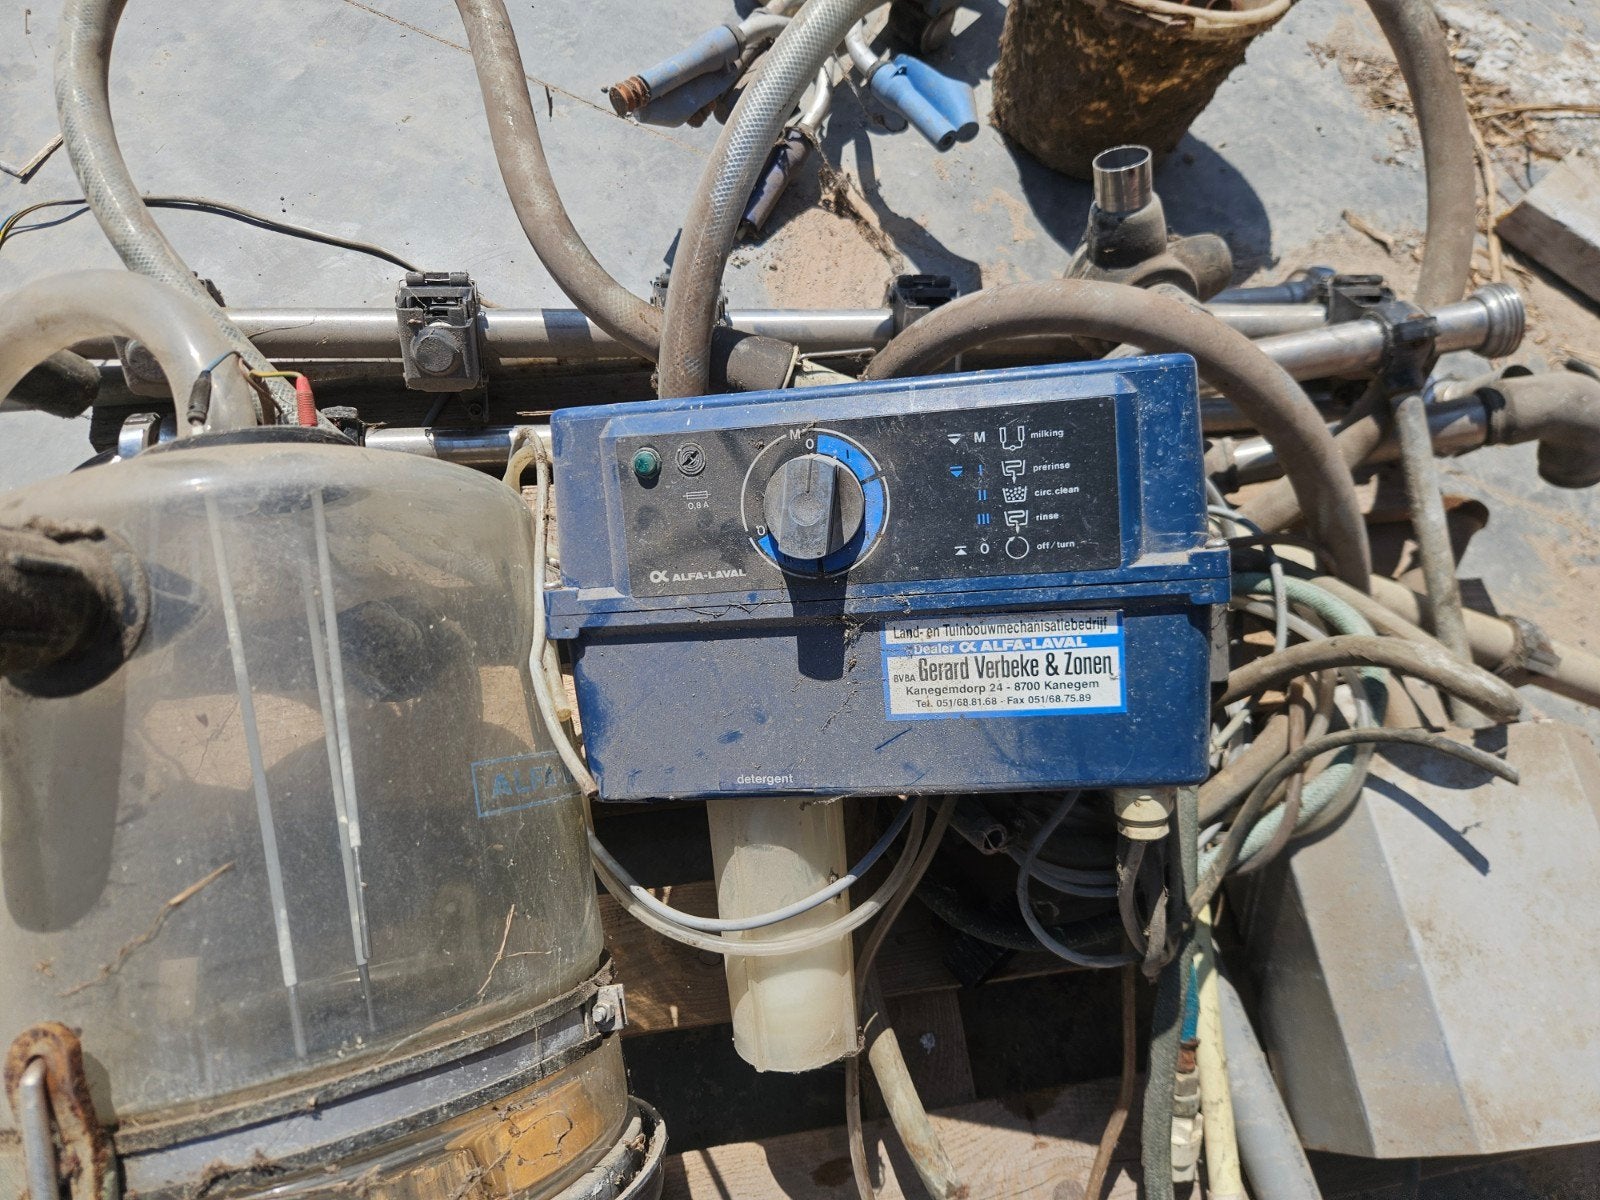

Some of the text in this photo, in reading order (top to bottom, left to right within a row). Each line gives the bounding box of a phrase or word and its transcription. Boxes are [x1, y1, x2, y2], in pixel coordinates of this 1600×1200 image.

[790, 429, 801, 440] M
[973, 427, 1065, 443] M milking
[1032, 460, 1071, 473] prerinse
[1035, 512, 1060, 522] rinse
[672, 567, 747, 582] ALFA-LAVAL
[893, 616, 1109, 640] Land- en Tuinbouwmechanisatiebedrijf
[913, 643, 955, 655] Dealer
[980, 636, 1088, 652] ALFA-LAVAL
[893, 651, 1113, 683] BVBA Gerard Verbeke & Zonen
[906, 684, 986, 696] Kanegemdorp
[989, 683, 1003, 693] 24
[1014, 681, 1041, 691] 8700
[1044, 680, 1100, 692] Kanegem
[916, 699, 933, 708] Tel.
[936, 697, 998, 708] 051/68.81.68
[1007, 695, 1025, 705] Fax
[1028, 693, 1092, 704] 051/68.75.89
[736, 773, 794, 786] detergent
